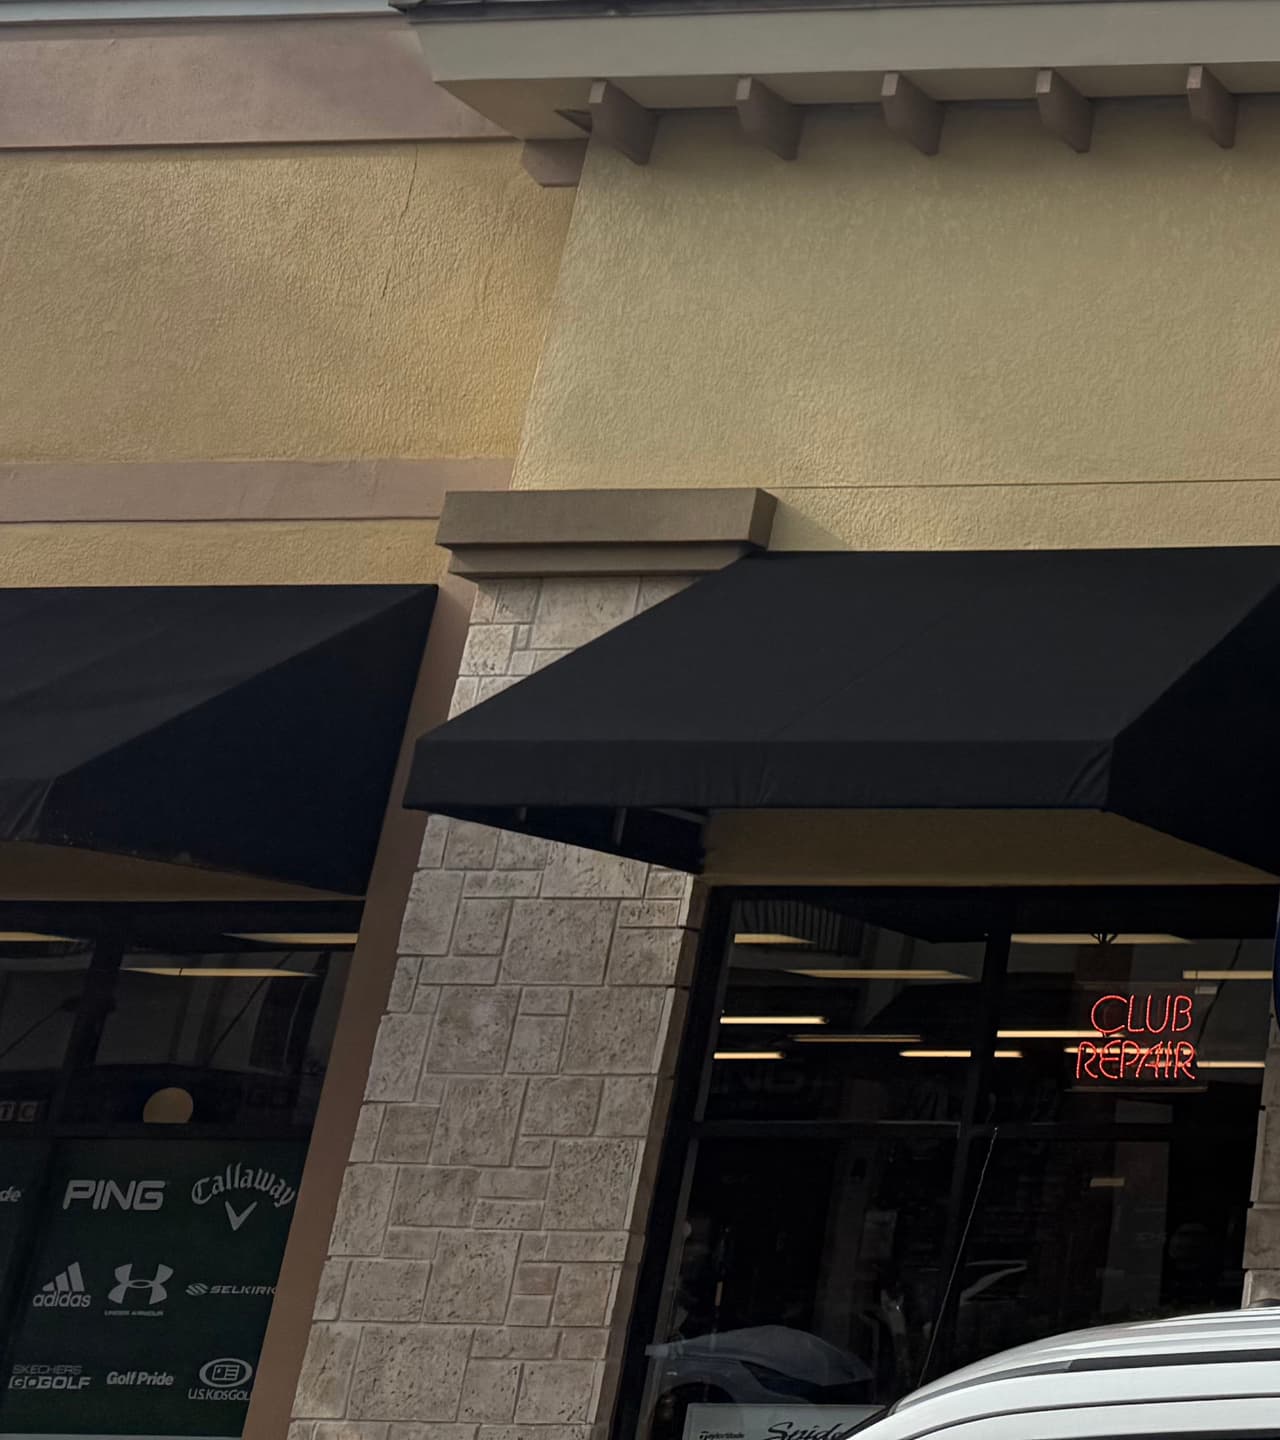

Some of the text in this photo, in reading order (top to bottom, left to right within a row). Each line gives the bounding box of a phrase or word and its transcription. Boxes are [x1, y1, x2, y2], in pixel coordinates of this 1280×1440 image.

[1089, 993, 1194, 1035] CLUB
[1075, 1039, 1197, 1080] REPAIR
[62, 1179, 166, 1211] PING
[191, 1162, 297, 1209] Callaway
[32, 1290, 91, 1308] adidas
[12, 1364, 83, 1375] SKECHERS
